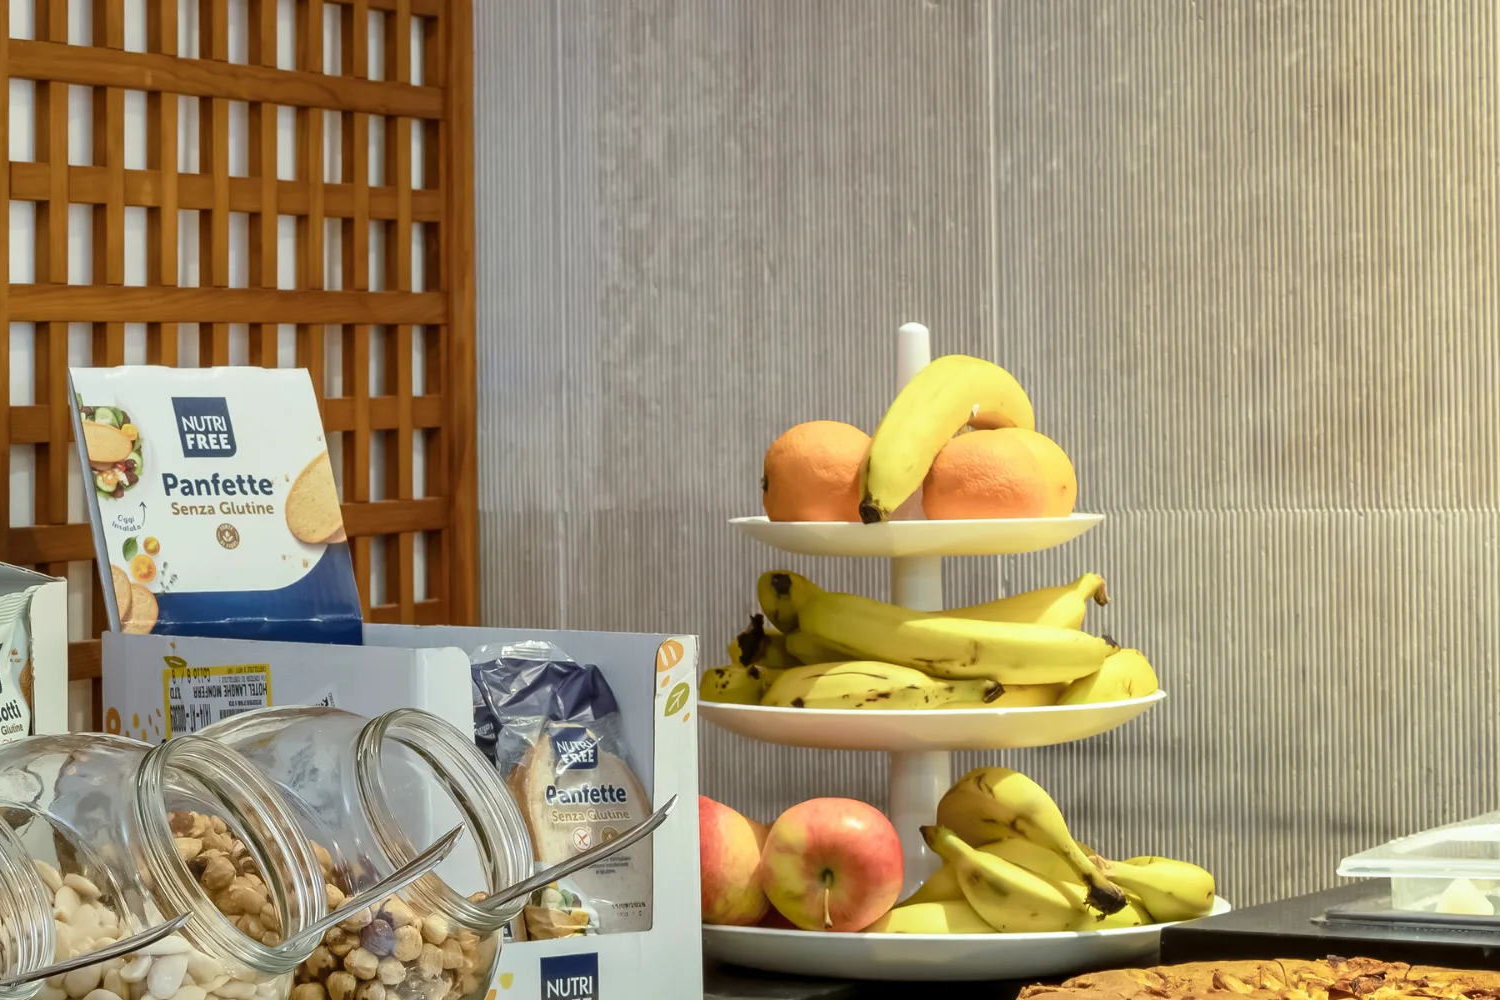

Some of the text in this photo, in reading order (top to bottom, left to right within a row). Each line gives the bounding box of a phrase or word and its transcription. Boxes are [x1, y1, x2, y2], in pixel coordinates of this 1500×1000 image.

[181, 415, 227, 432] NUTRI
[185, 433, 232, 450] FREE
[161, 472, 274, 497] Panfette
[170, 501, 275, 516] Senza Glutine
[248, 683, 267, 697] HOTEL
[0, 721, 24, 736] Glutine
[545, 784, 627, 805] Panfette
[551, 809, 631, 823] Senza Glutine
[546, 976, 593, 998] NUTRI
